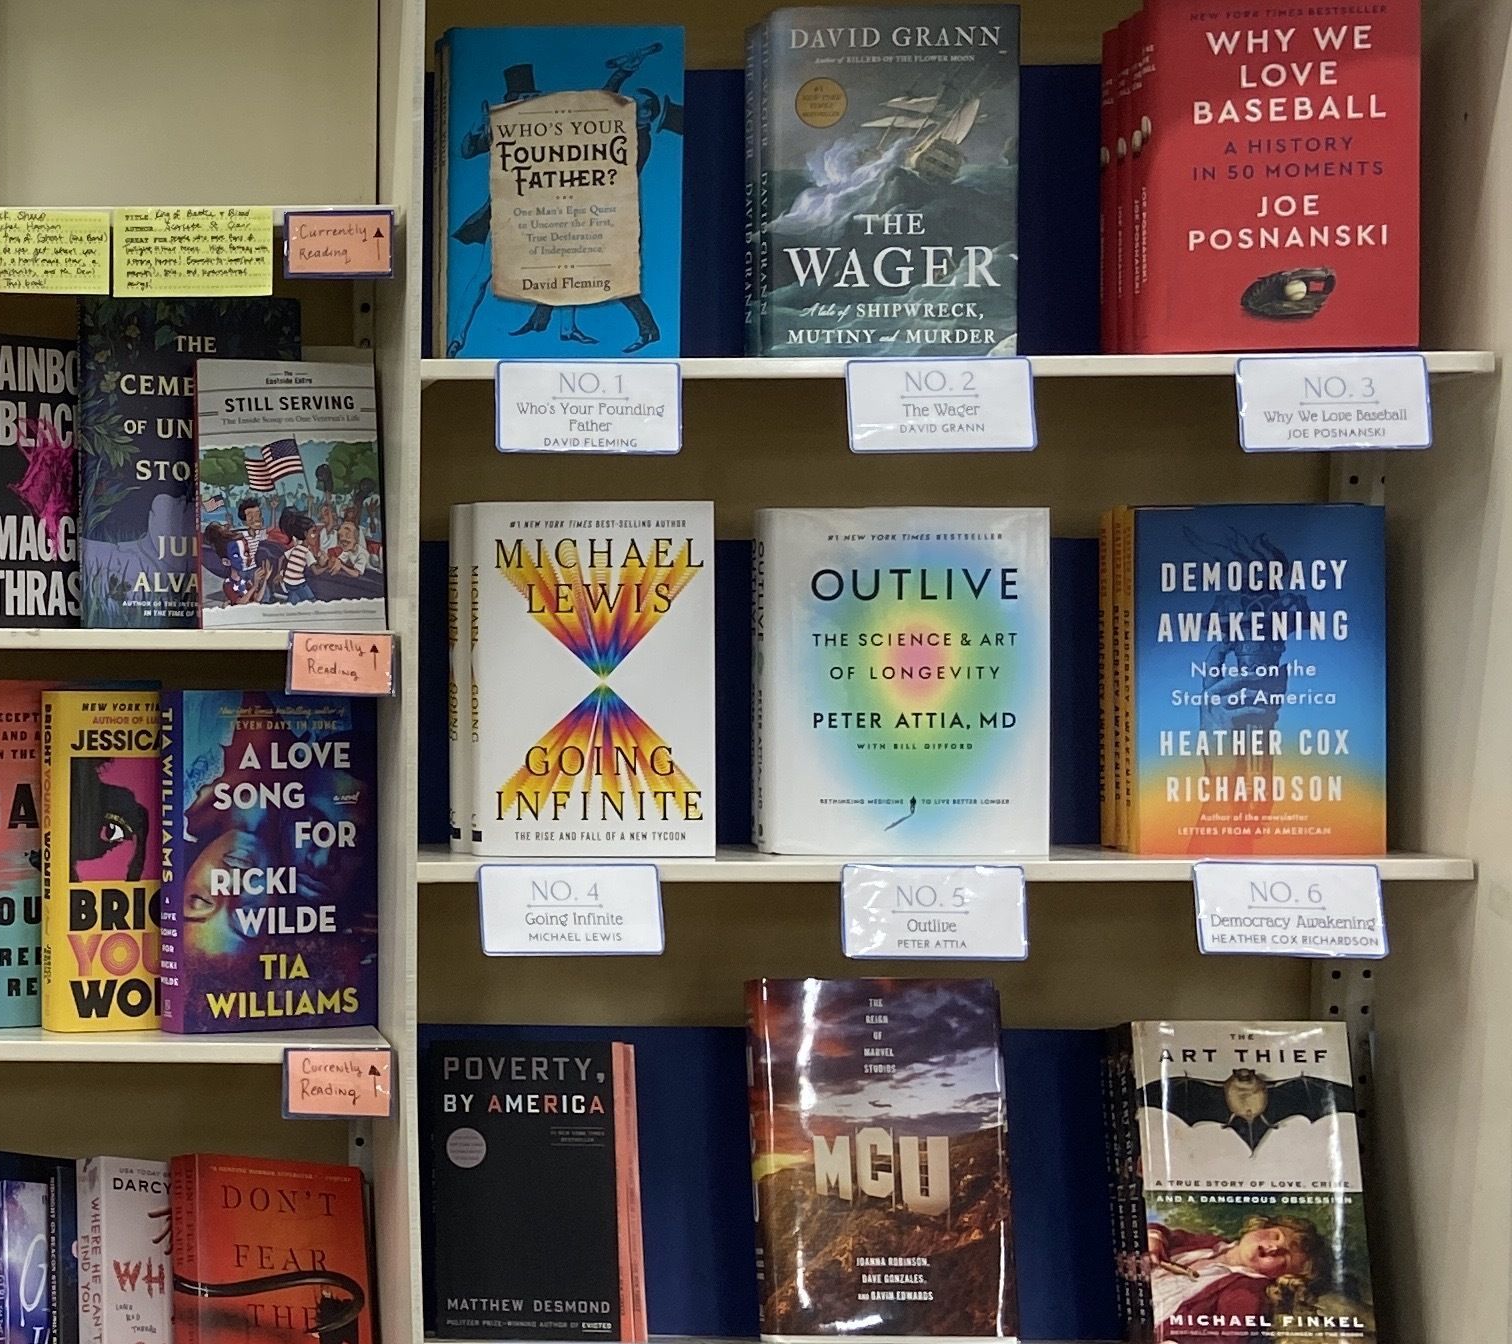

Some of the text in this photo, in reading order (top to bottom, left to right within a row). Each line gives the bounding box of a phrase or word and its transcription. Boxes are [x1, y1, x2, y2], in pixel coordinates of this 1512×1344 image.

[791, 27, 1000, 48] DAVID GRANN
[1206, 25, 1372, 55] WHY WE
[1240, 62, 1337, 88] LOVE
[1193, 95, 1387, 125] BASEBALL
[497, 120, 624, 137] WHO'S YOUR
[496, 136, 627, 171] FOUNDING
[512, 168, 617, 195] FATHER?
[1257, 195, 1320, 217] JOE
[855, 213, 925, 235] THE
[1189, 225, 1388, 251] POSNANSKI
[783, 246, 1001, 288] WAGER
[521, 276, 611, 292] David Fleming
[559, 373, 623, 393] NO. 1
[905, 371, 976, 392] NO. 2
[1304, 377, 1375, 398] NO. 3
[224, 395, 354, 413] STILL SERVING
[903, 403, 980, 418] The Wager
[900, 423, 985, 433] DAVID GRANN
[494, 538, 704, 568] MICHAEL
[811, 568, 1018, 601] OUTLIVE
[1161, 560, 1347, 592] DEMOCRACY
[527, 583, 672, 613] LEWIS
[1158, 610, 1349, 642] AWAKENING
[814, 712, 1016, 730] PETER ATTIA, MD
[239, 742, 350, 770] A LOVE
[526, 745, 674, 776] GOING
[213, 782, 305, 810] SONG
[496, 791, 703, 821] INFINITE
[295, 821, 355, 849] FOR
[210, 867, 297, 895] RICKI
[235, 906, 336, 935] WILDE
[260, 953, 309, 980] TIA
[206, 987, 359, 1019] WILLIAMS
